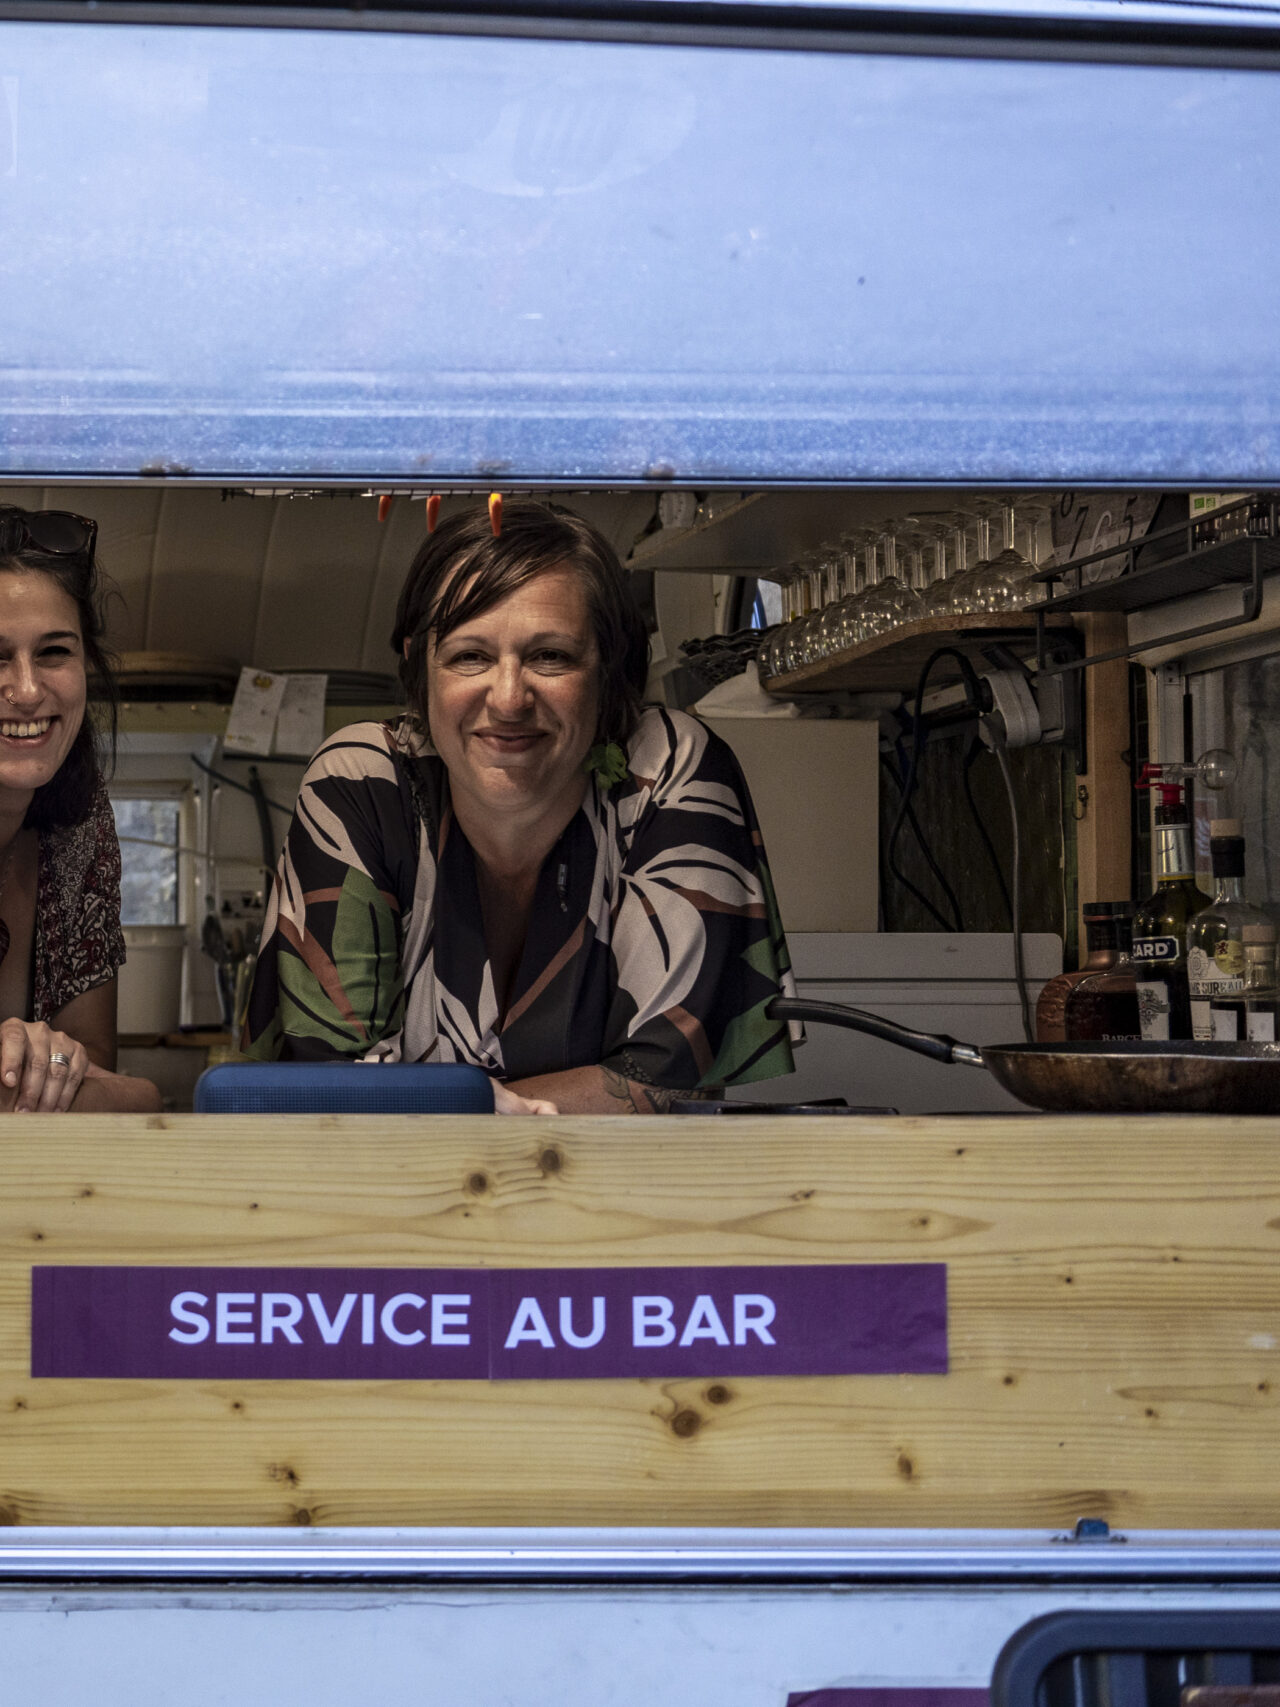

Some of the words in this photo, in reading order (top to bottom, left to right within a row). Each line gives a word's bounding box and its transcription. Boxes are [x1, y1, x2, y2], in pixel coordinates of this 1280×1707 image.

[168, 1292, 471, 1346] SERVICE
[504, 1296, 607, 1349] AU
[632, 1294, 777, 1348] BAR
